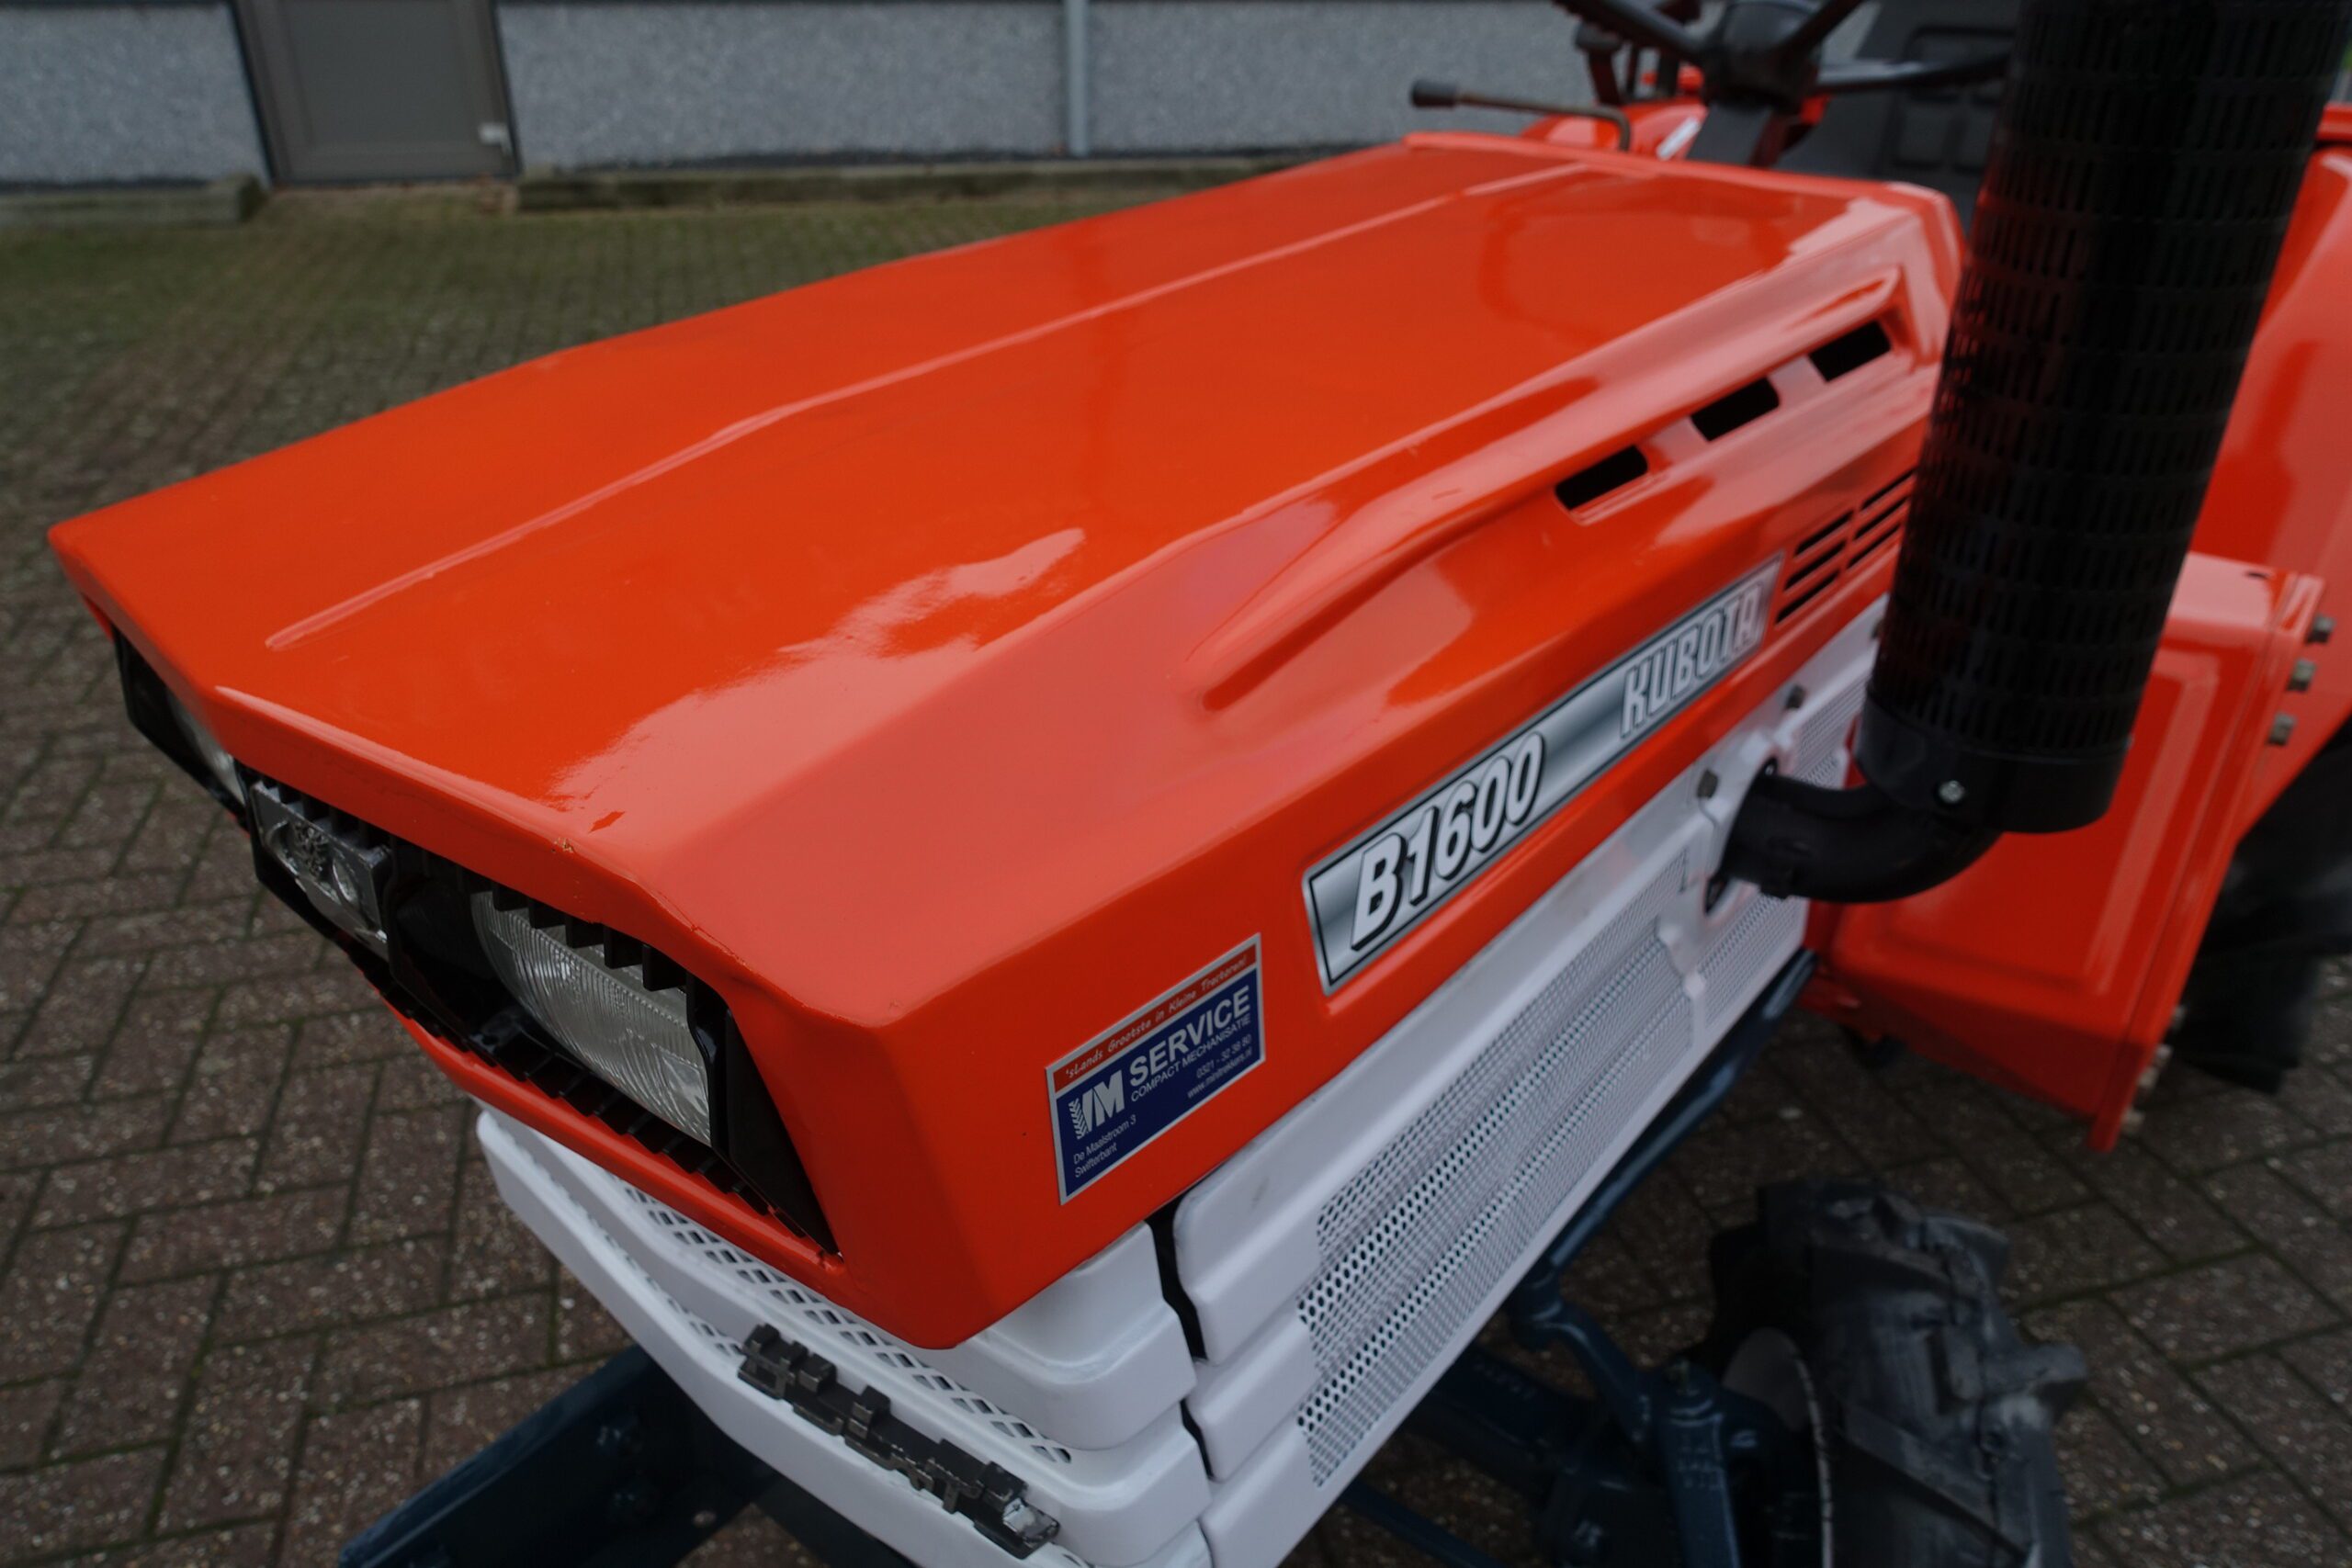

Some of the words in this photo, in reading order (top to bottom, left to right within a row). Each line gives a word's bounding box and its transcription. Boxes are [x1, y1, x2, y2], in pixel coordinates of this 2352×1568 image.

[1351, 732, 1544, 950] B1600
[1622, 583, 1763, 739] KUBOTA
[1108, 1019, 1151, 1053] Grootste
[1155, 1008, 1164, 1022] in
[1168, 987, 1195, 1014] Kleine
[1129, 985, 1250, 1088] SERVICE
[1131, 1061, 1181, 1102] COMPACT
[1182, 1013, 1250, 1067] MECHANISATIE
[1073, 1148, 1084, 1165] De
[1085, 1120, 1130, 1156] Maalstroom
[1130, 1113, 1136, 1126] 3
[1075, 1142, 1117, 1178] Swifterbant
